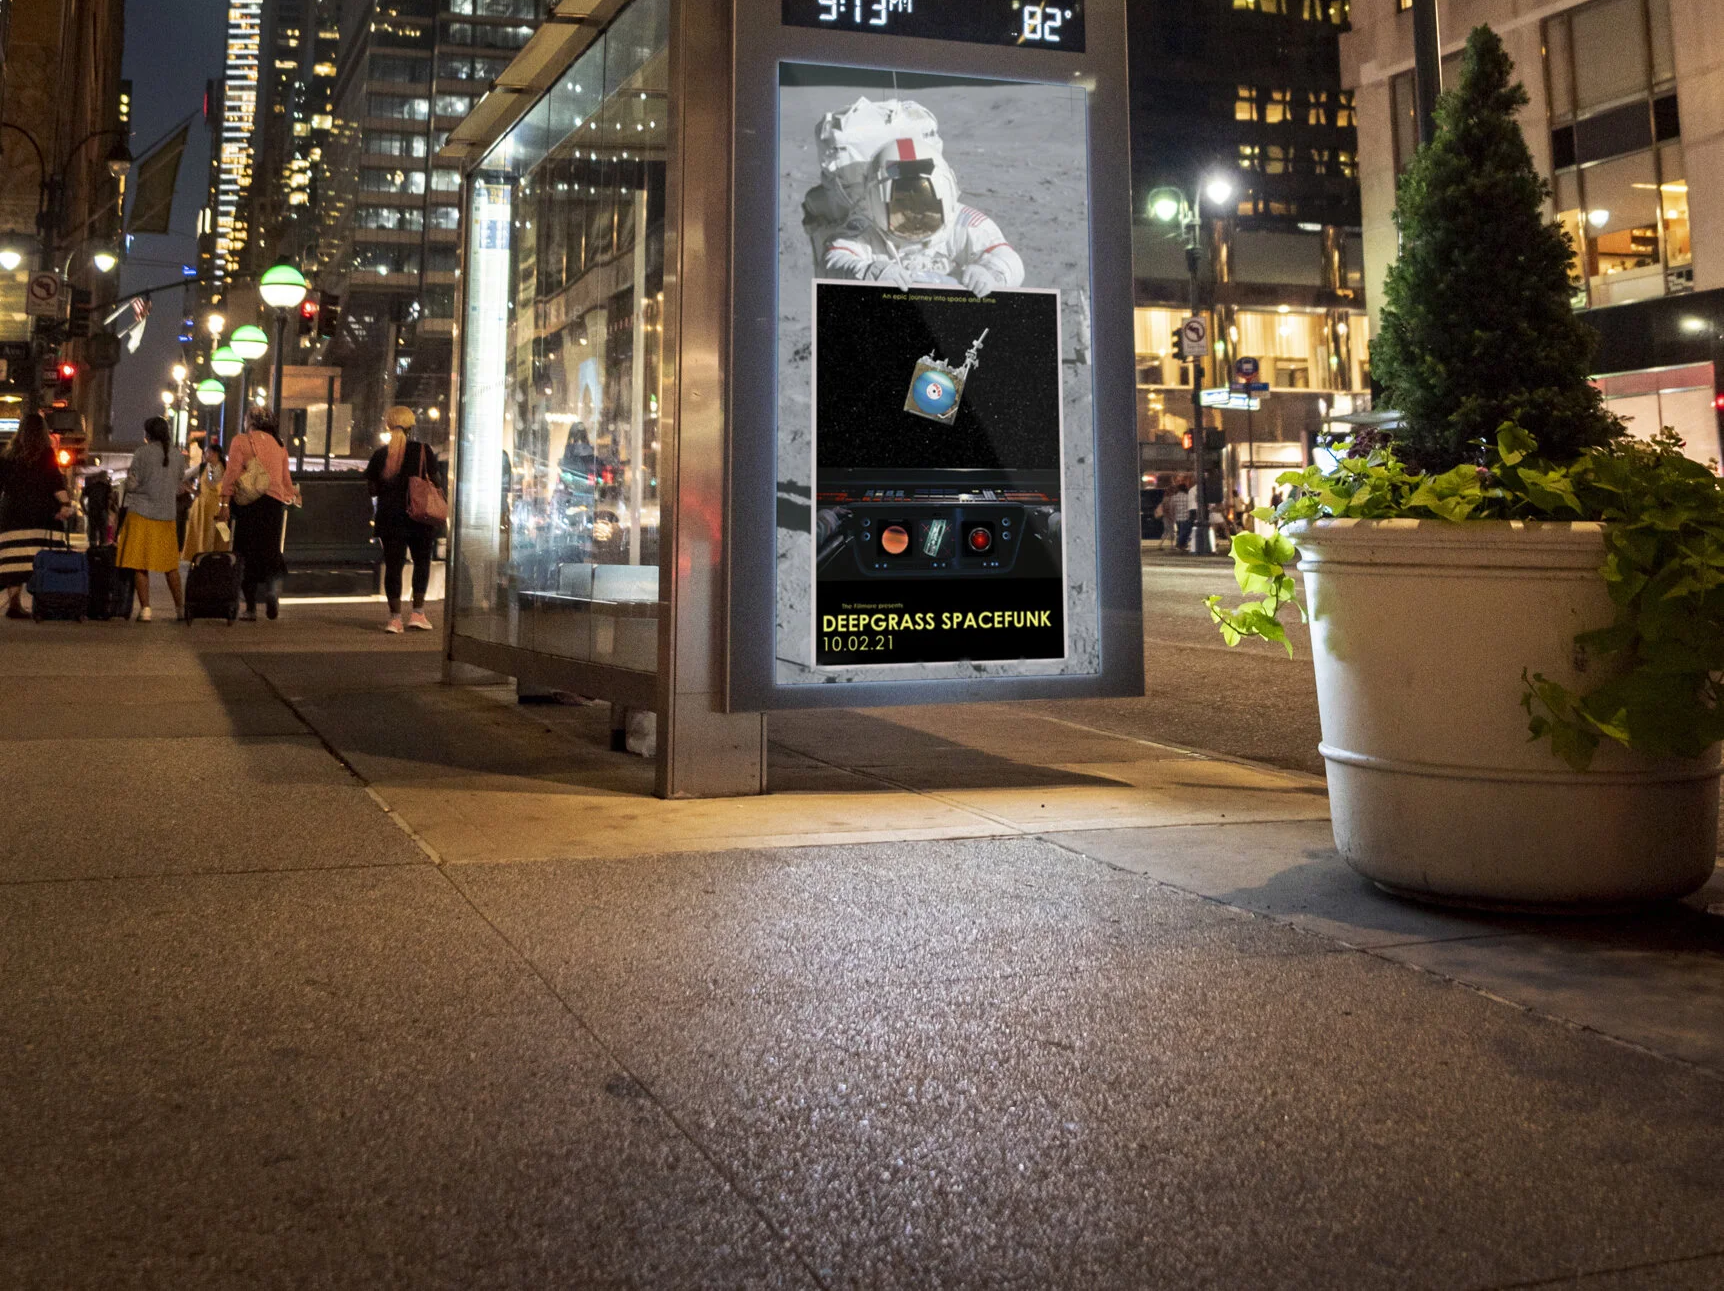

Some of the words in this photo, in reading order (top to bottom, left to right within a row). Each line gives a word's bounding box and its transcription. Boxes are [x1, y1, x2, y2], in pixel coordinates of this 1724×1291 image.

[909, 294, 932, 302] journey
[823, 613, 936, 632] DEEPGRASS
[941, 610, 1052, 630] SPACEFUNK
[823, 635, 894, 652] 10.02.21
